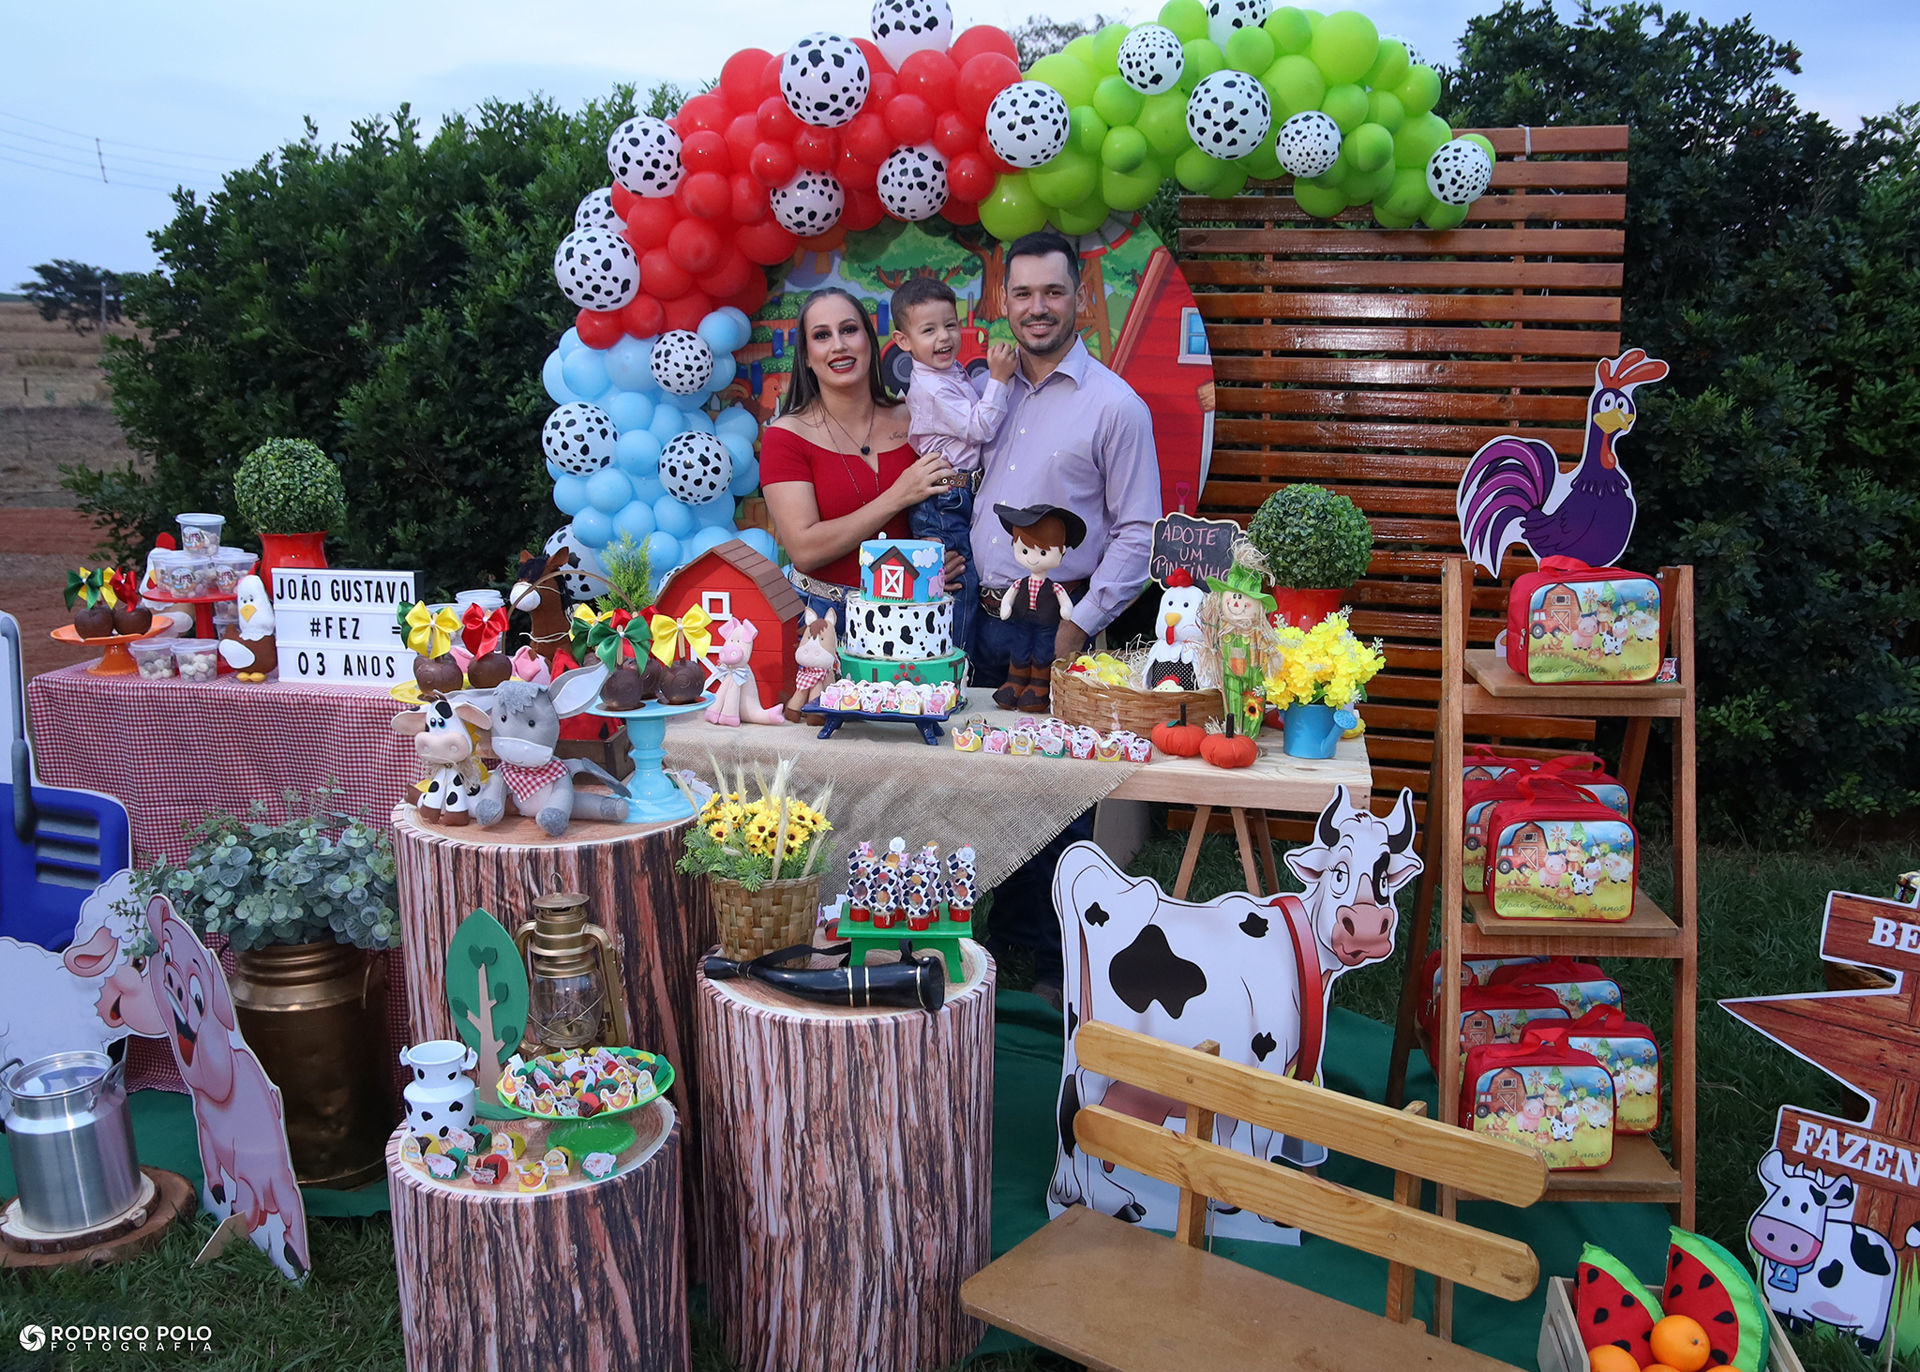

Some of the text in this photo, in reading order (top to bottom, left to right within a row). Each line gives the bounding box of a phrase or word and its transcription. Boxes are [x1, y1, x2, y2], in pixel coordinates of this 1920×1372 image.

[1161, 523, 1220, 546] ADOTE
[1180, 546, 1203, 561] UM
[276, 574, 410, 604] JOÃO GUSTAVO
[309, 616, 361, 640] #FEZ
[342, 653, 396, 679] ANOS
